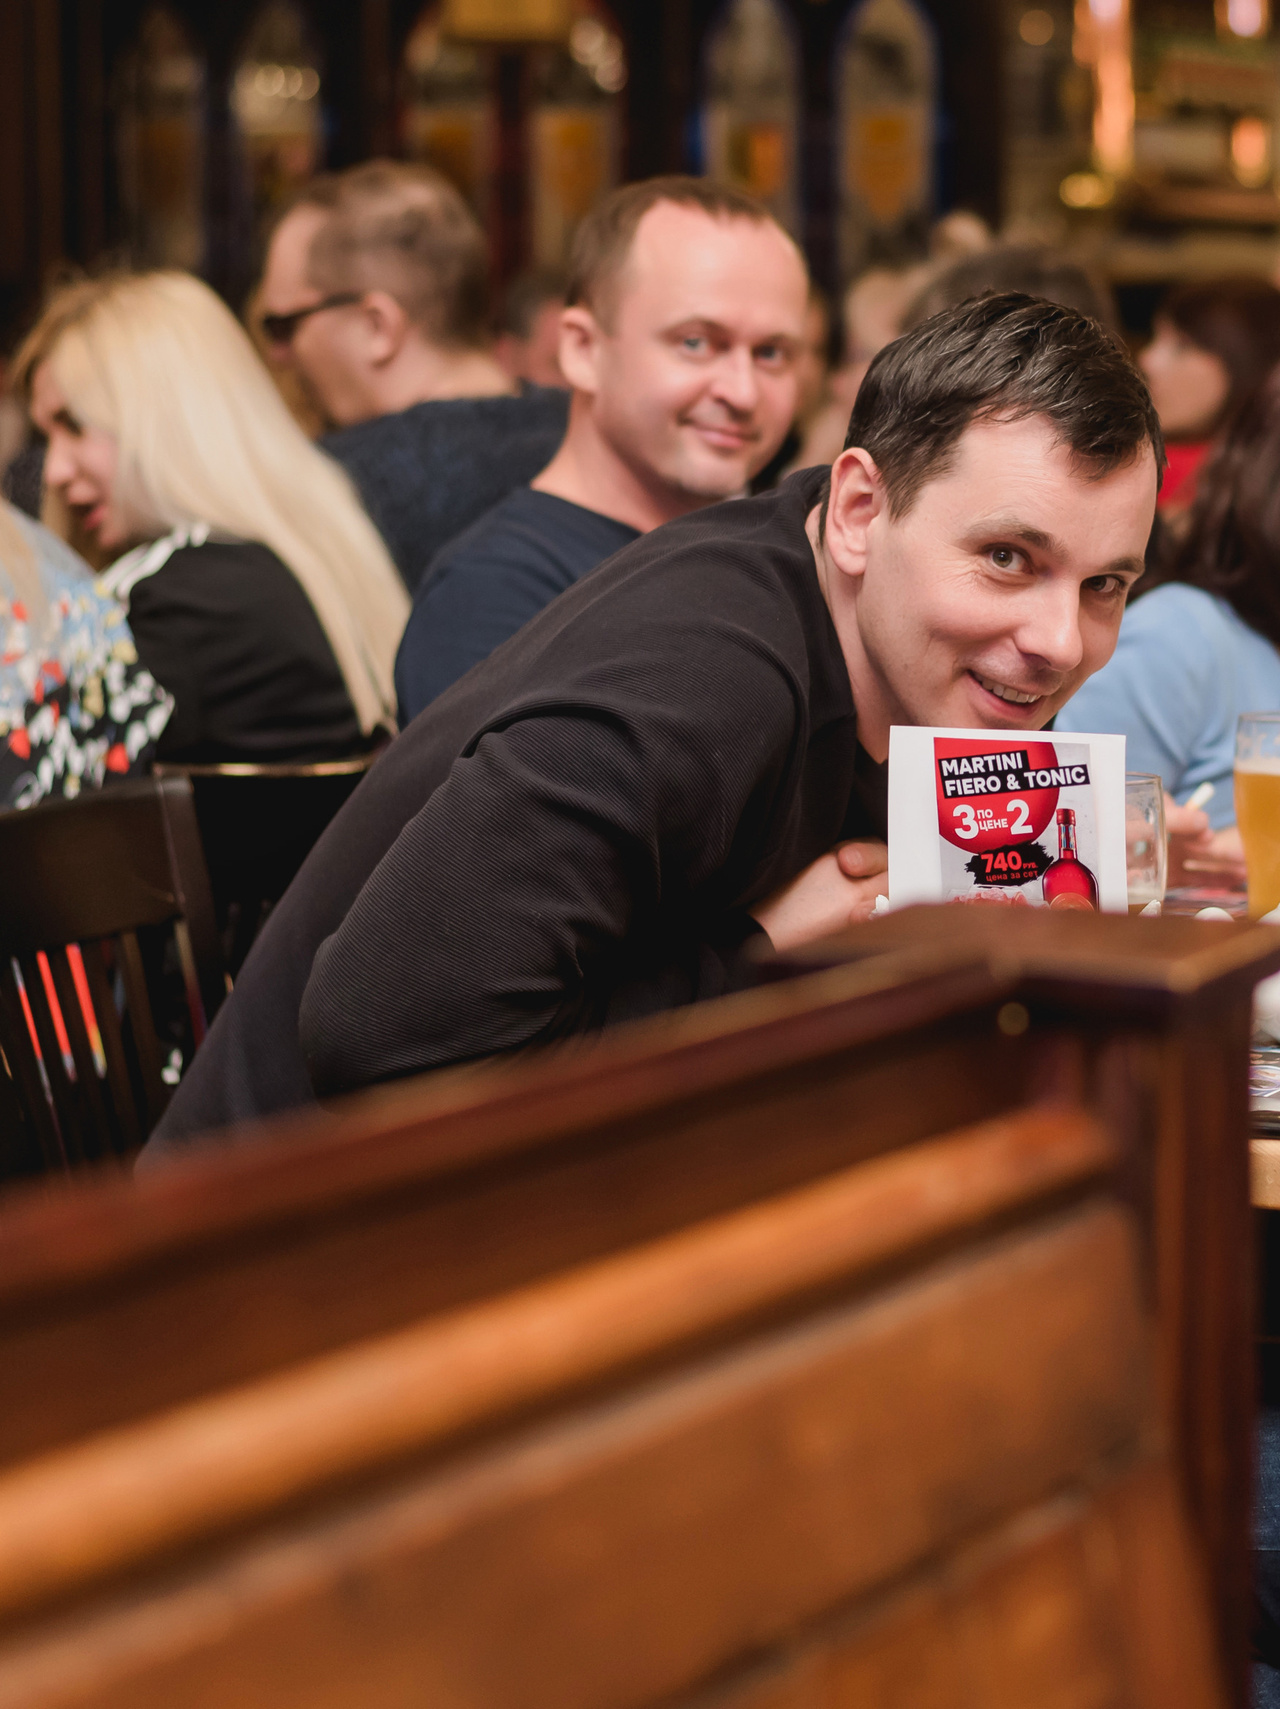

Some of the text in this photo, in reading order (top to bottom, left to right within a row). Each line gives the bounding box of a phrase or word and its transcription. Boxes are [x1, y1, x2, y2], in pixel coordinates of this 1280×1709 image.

[941, 752, 1023, 777] MARTINI
[944, 766, 1086, 796] FIERO & TONIC
[952, 798, 1034, 840] 3 ПО ЦЕНЕ 2
[980, 850, 1022, 873] 740
[985, 870, 1039, 883] цена за сет
